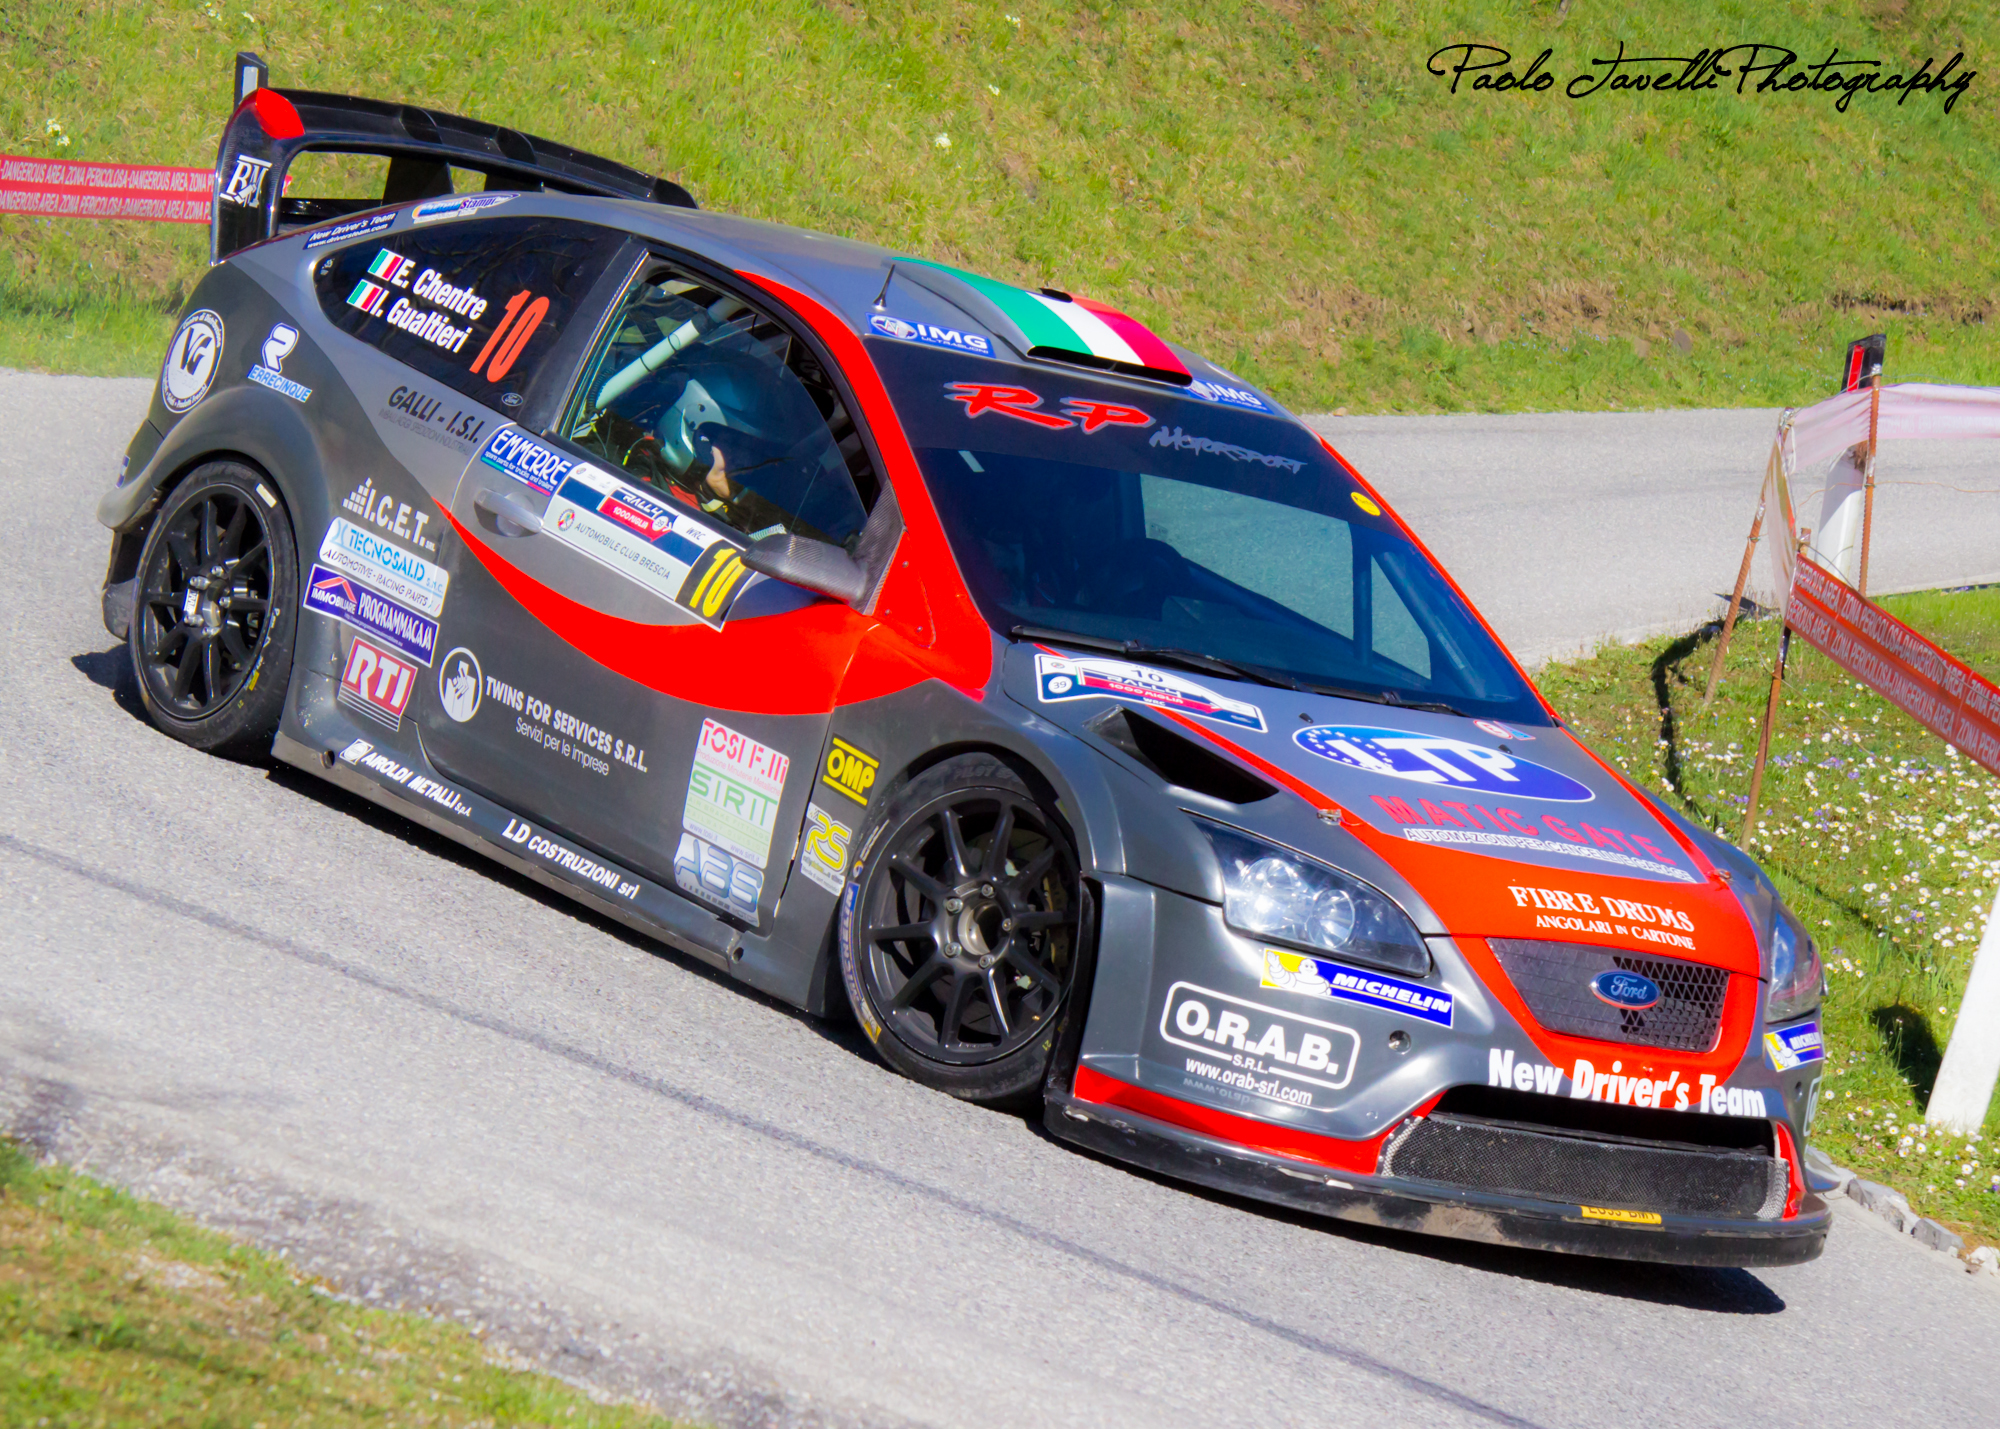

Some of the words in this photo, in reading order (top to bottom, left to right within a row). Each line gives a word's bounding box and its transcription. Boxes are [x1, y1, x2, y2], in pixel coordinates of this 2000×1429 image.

[45, 164, 66, 184] AREA
[64, 166, 86, 187] ZONA
[169, 172, 188, 191] AREA
[189, 173, 207, 192] ZONA
[40, 193, 60, 213] AREA
[59, 194, 80, 214] ZONA
[165, 201, 185, 219] AREA
[184, 201, 204, 219] ZONA
[309, 229, 332, 242] New
[332, 218, 369, 237] Driver's
[369, 212, 397, 226] Team
[390, 258, 416, 289] E.
[413, 269, 488, 321] Chentre
[370, 290, 390, 318] I.
[386, 298, 473, 353] Gualtieri
[469, 289, 550, 383] 10
[917, 322, 988, 350] IMG
[249, 366, 311, 402] ERRECINQUE
[1206, 382, 1262, 406] IMG
[388, 385, 442, 422] GALLI
[445, 410, 486, 444] I.S.I.
[490, 429, 573, 485] EMMERRE
[495, 456, 509, 467] parts
[514, 466, 530, 478] trucks
[528, 473, 539, 483] and
[537, 478, 554, 492] trailers
[363, 488, 430, 548] I.C.E.T.
[613, 506, 631, 520] 1000
[622, 494, 663, 519] RALLY
[349, 528, 425, 582] TECNOSALD
[574, 523, 621, 552] AUTOMOBILE
[619, 546, 640, 562] CLUB
[639, 556, 671, 580] BRESCIA
[686, 527, 706, 540] WRC
[311, 587, 357, 615] IMMOBILIARE
[323, 549, 374, 579] AUTOMOTIVE
[376, 573, 405, 595] RACING
[405, 588, 429, 607] PARTS
[689, 548, 747, 617] 10
[1821, 580, 1844, 613] AREA
[1838, 592, 1861, 628] ZONA
[1941, 664, 1967, 700] AREA
[347, 644, 411, 708] RTI
[1053, 678, 1067, 689] 39
[1107, 675, 1183, 699] RALLY
[1109, 682, 1141, 694] 1000
[1143, 691, 1184, 704] MIGLIA
[1129, 669, 1164, 683] 10
[1809, 615, 1833, 647] AREA
[1829, 629, 1853, 664] ZONA
[1931, 701, 1955, 737] AREA
[1954, 717, 1980, 754] ZONA
[485, 675, 525, 711] TWINS
[525, 695, 551, 725] FOR
[552, 709, 613, 755] SERVICES
[613, 739, 648, 773] S.R.L.
[1143, 697, 1166, 706] WRC
[516, 717, 543, 744] Servizi
[543, 734, 561, 752] per
[561, 739, 571, 757] le
[571, 743, 610, 776] imprese
[702, 719, 746, 763] TOSI
[1324, 738, 1521, 783] LTP
[362, 752, 412, 783] AIROLDI
[407, 774, 461, 808] METALLI
[697, 747, 726, 770] Produzione
[727, 763, 752, 782] Minuterie
[753, 776, 781, 797] Metalliche
[827, 748, 875, 794] OMP
[689, 766, 778, 827] SIRIT
[1368, 794, 1540, 836] MATIC
[1540, 813, 1678, 867] GATE
[1404, 827, 1515, 848] AUTOMAZIONI
[1514, 837, 1547, 850] PER
[501, 819, 531, 844] LD
[527, 834, 620, 890] COSTRUZIONI
[617, 881, 640, 900] srl
[1508, 886, 1601, 915] FIBRE
[1601, 896, 1696, 932] DRUMS
[1536, 914, 1613, 935] ANGOLARI
[1616, 924, 1628, 935] IN
[1631, 926, 1696, 951] CARTONE
[1332, 972, 1452, 1013] MICHELIN
[1610, 975, 1648, 1001] Ford
[1176, 1000, 1339, 1075] O.R.A.B.
[1185, 1057, 1313, 1106] www.orab-srl.com
[1232, 1053, 1268, 1074] S.R.L.
[1488, 1048, 1564, 1095] New
[1571, 1059, 1690, 1112] Driver's
[1698, 1074, 1767, 1118] Team
